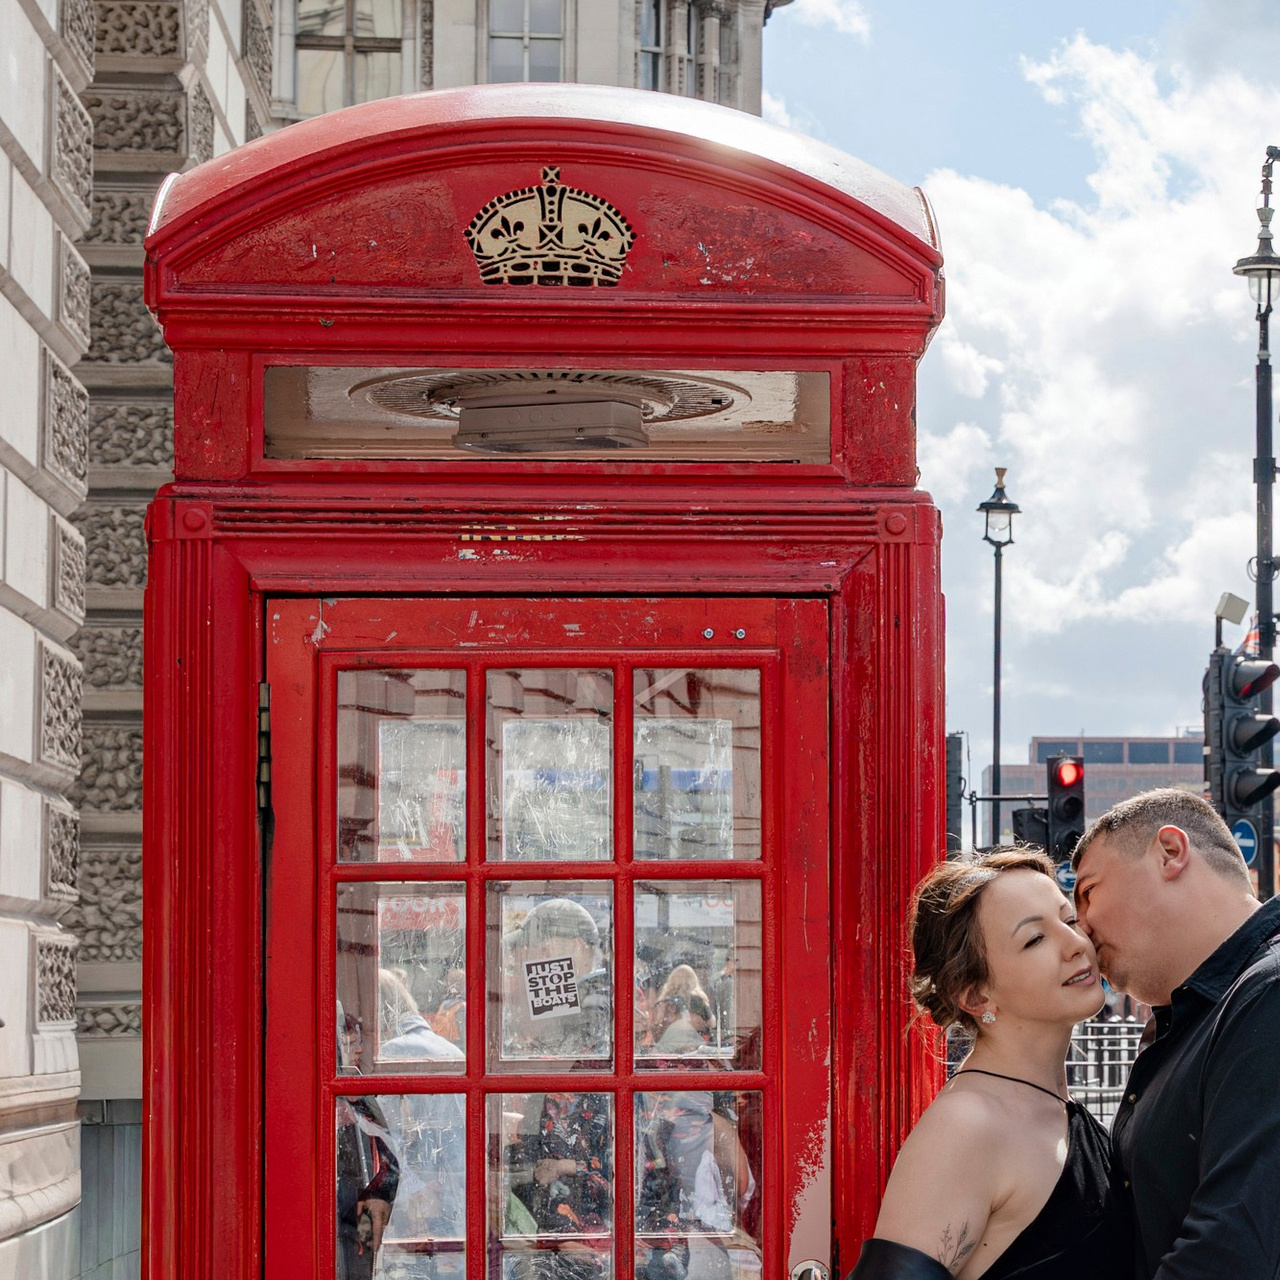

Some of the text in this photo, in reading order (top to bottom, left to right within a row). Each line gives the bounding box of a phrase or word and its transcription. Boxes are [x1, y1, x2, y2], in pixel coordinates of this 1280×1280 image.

[528, 960, 571, 976] JUST
[528, 972, 575, 988] STOP
[529, 982, 577, 998] THE
[532, 993, 576, 1008] BOATS
